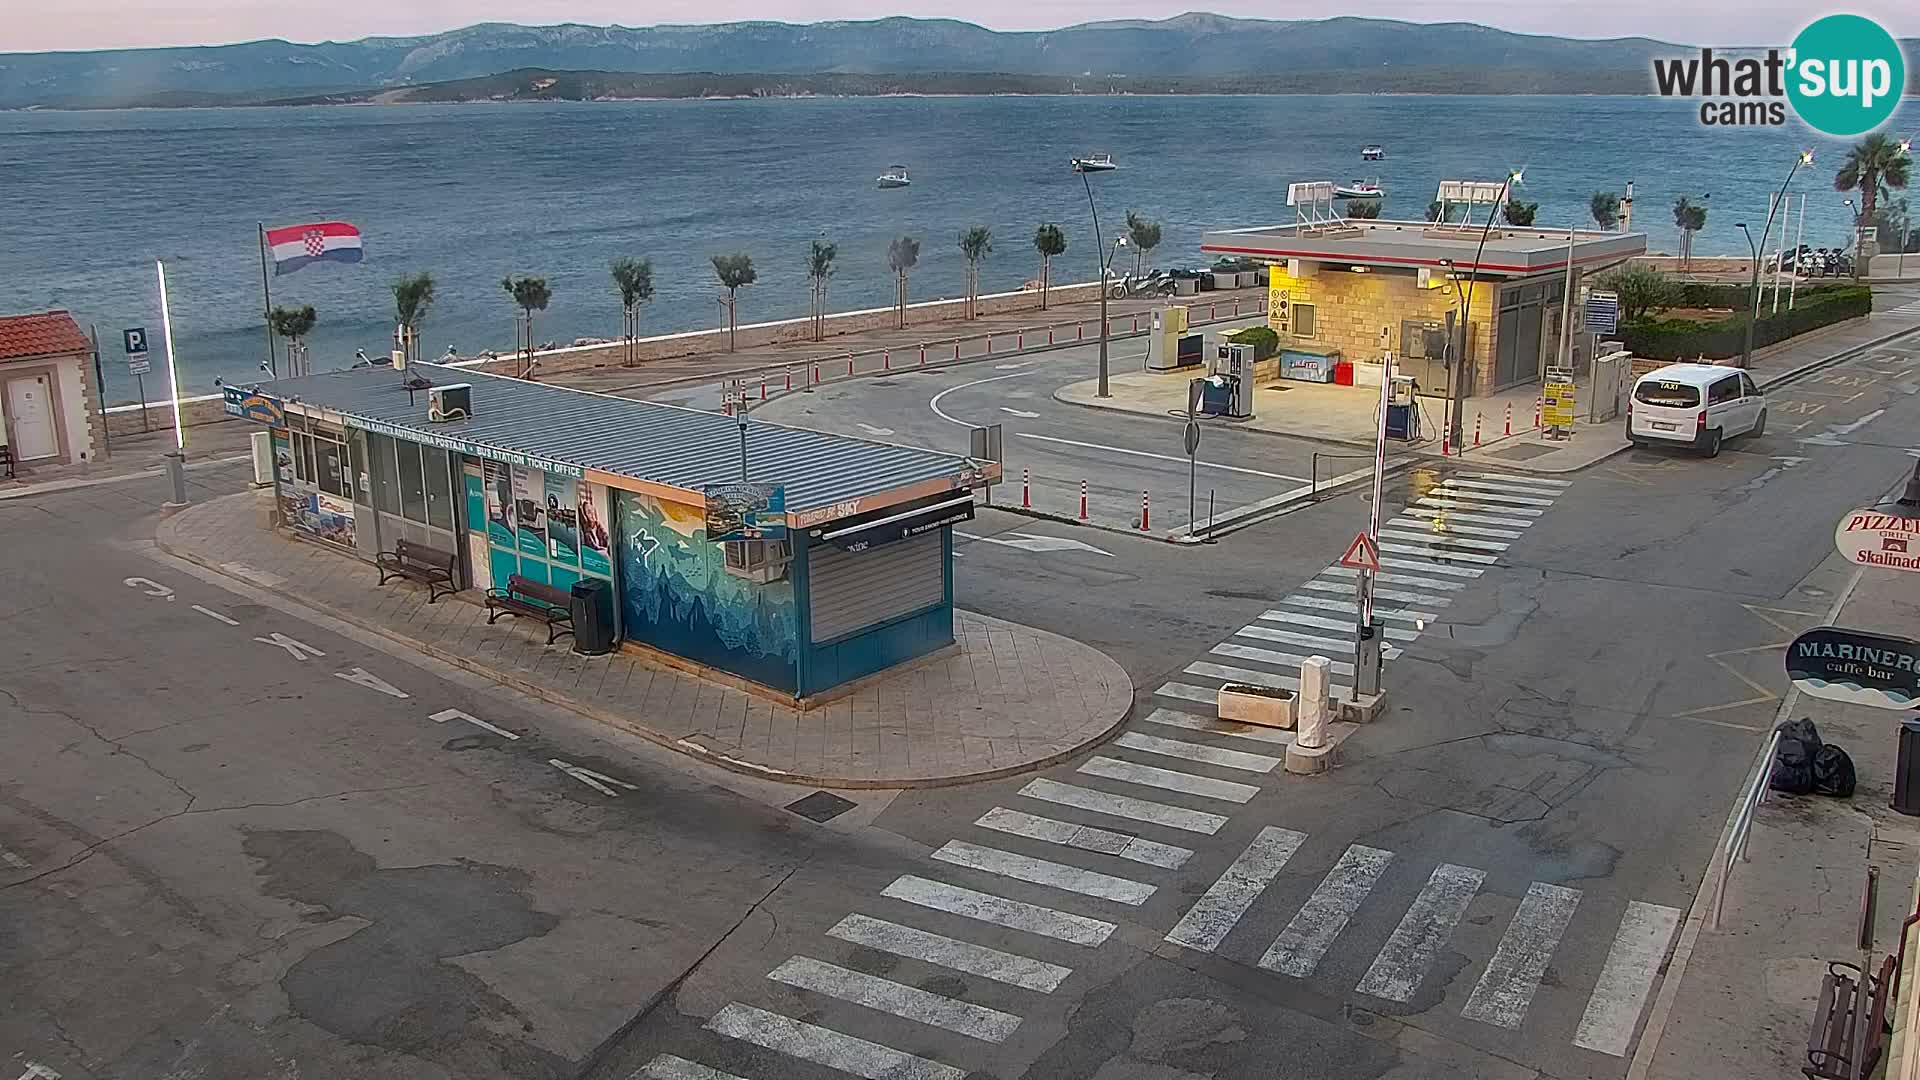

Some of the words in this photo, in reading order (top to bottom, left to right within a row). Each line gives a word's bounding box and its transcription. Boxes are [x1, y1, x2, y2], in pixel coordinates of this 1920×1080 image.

[129, 331, 141, 350] P
[435, 437, 467, 452] POSTAJA
[476, 446, 491, 458] BUS
[492, 449, 525, 465] STATION
[527, 455, 553, 471] TICKET
[554, 463, 581, 478] OFFICE
[1879, 531, 1914, 541] GRILL
[1826, 662, 1863, 675] caffe
[1867, 665, 1895, 680] bar
